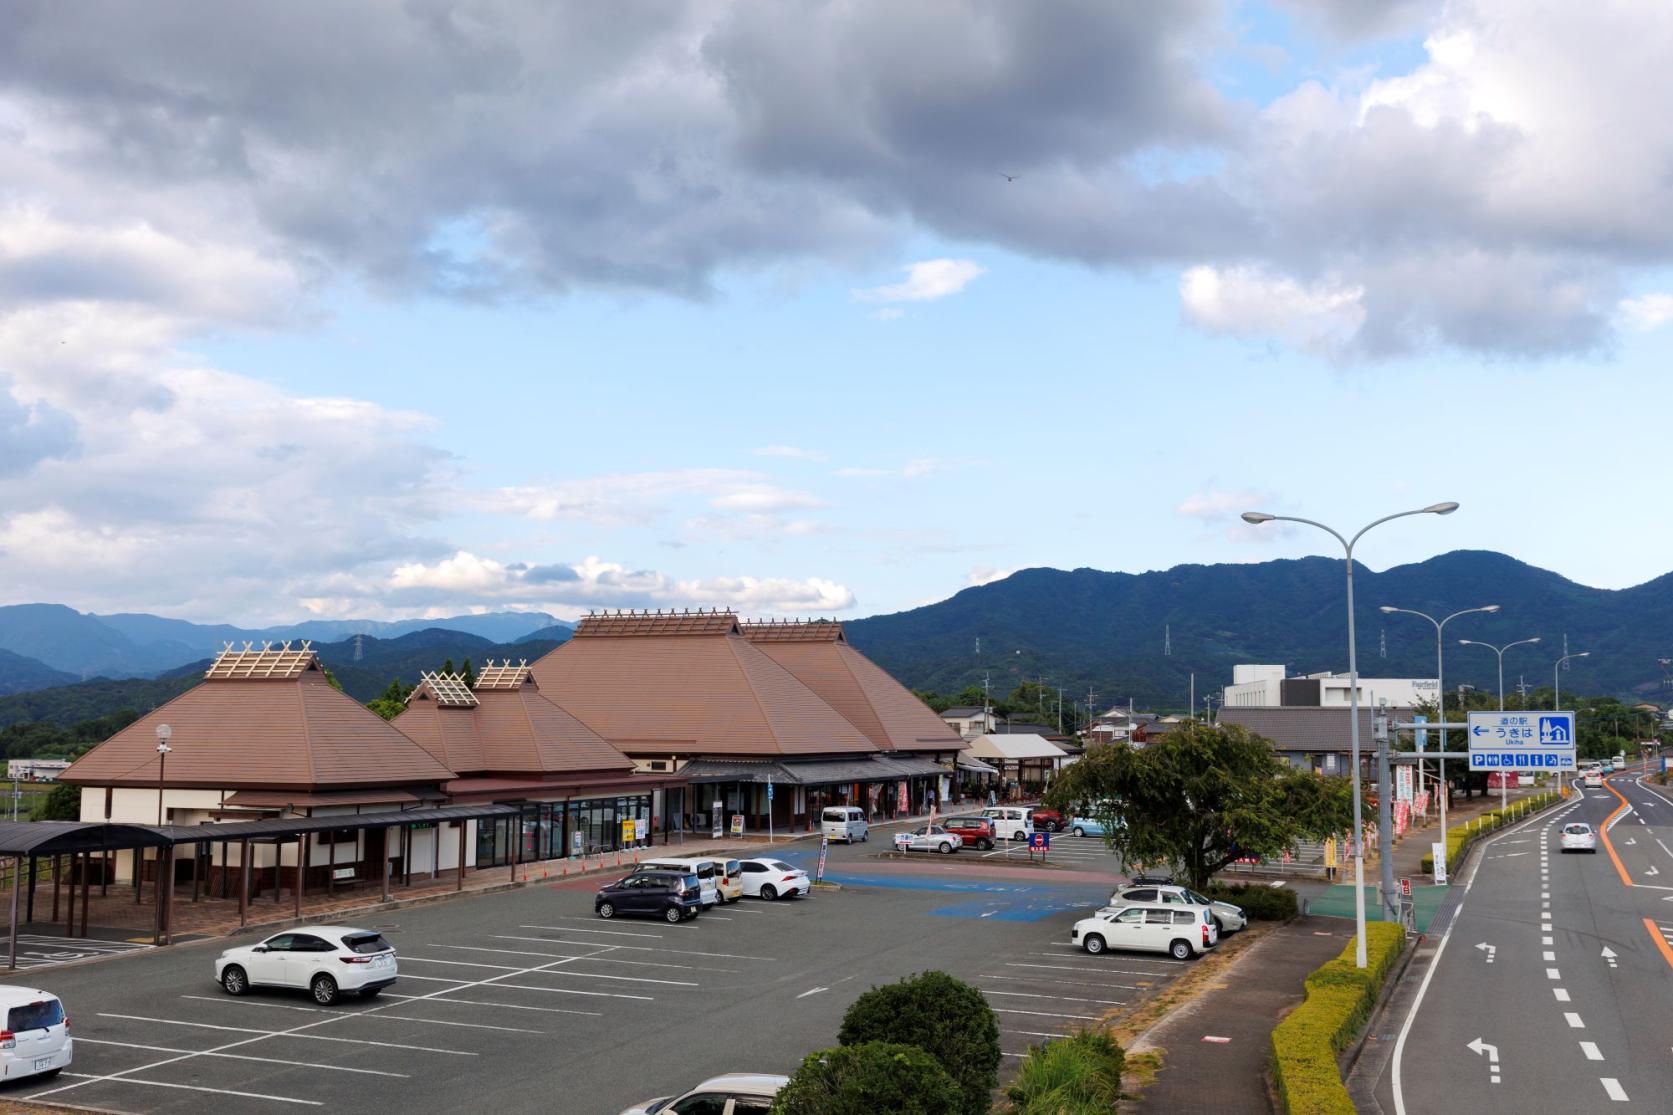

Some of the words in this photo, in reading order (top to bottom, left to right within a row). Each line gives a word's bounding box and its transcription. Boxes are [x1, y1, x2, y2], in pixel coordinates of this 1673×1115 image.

[1500, 717, 1528, 725] 道の駅
[1495, 728, 1533, 738] うきは
